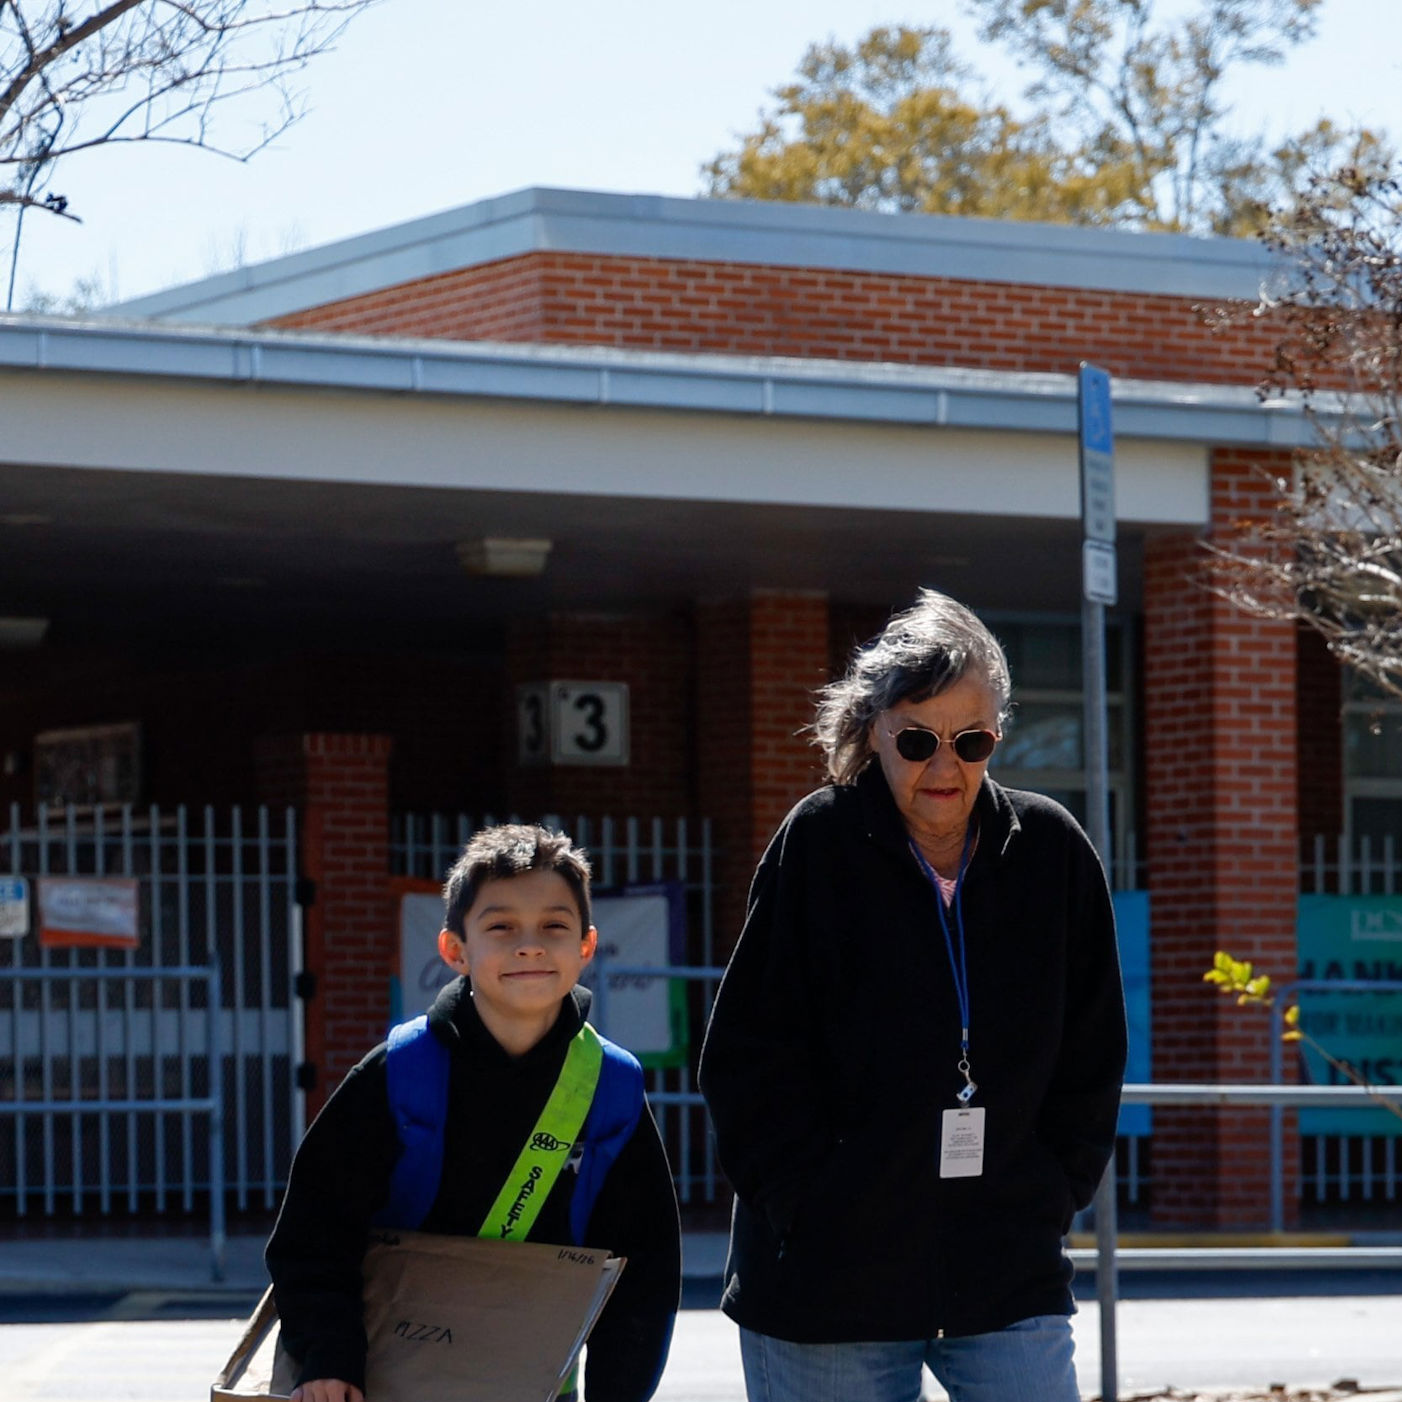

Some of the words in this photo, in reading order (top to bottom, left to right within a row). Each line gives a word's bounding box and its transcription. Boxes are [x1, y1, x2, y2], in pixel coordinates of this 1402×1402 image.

[573, 693, 607, 753] 3
[500, 1166, 543, 1239] SAFETY
[394, 1320, 453, 1344] PIZZA
